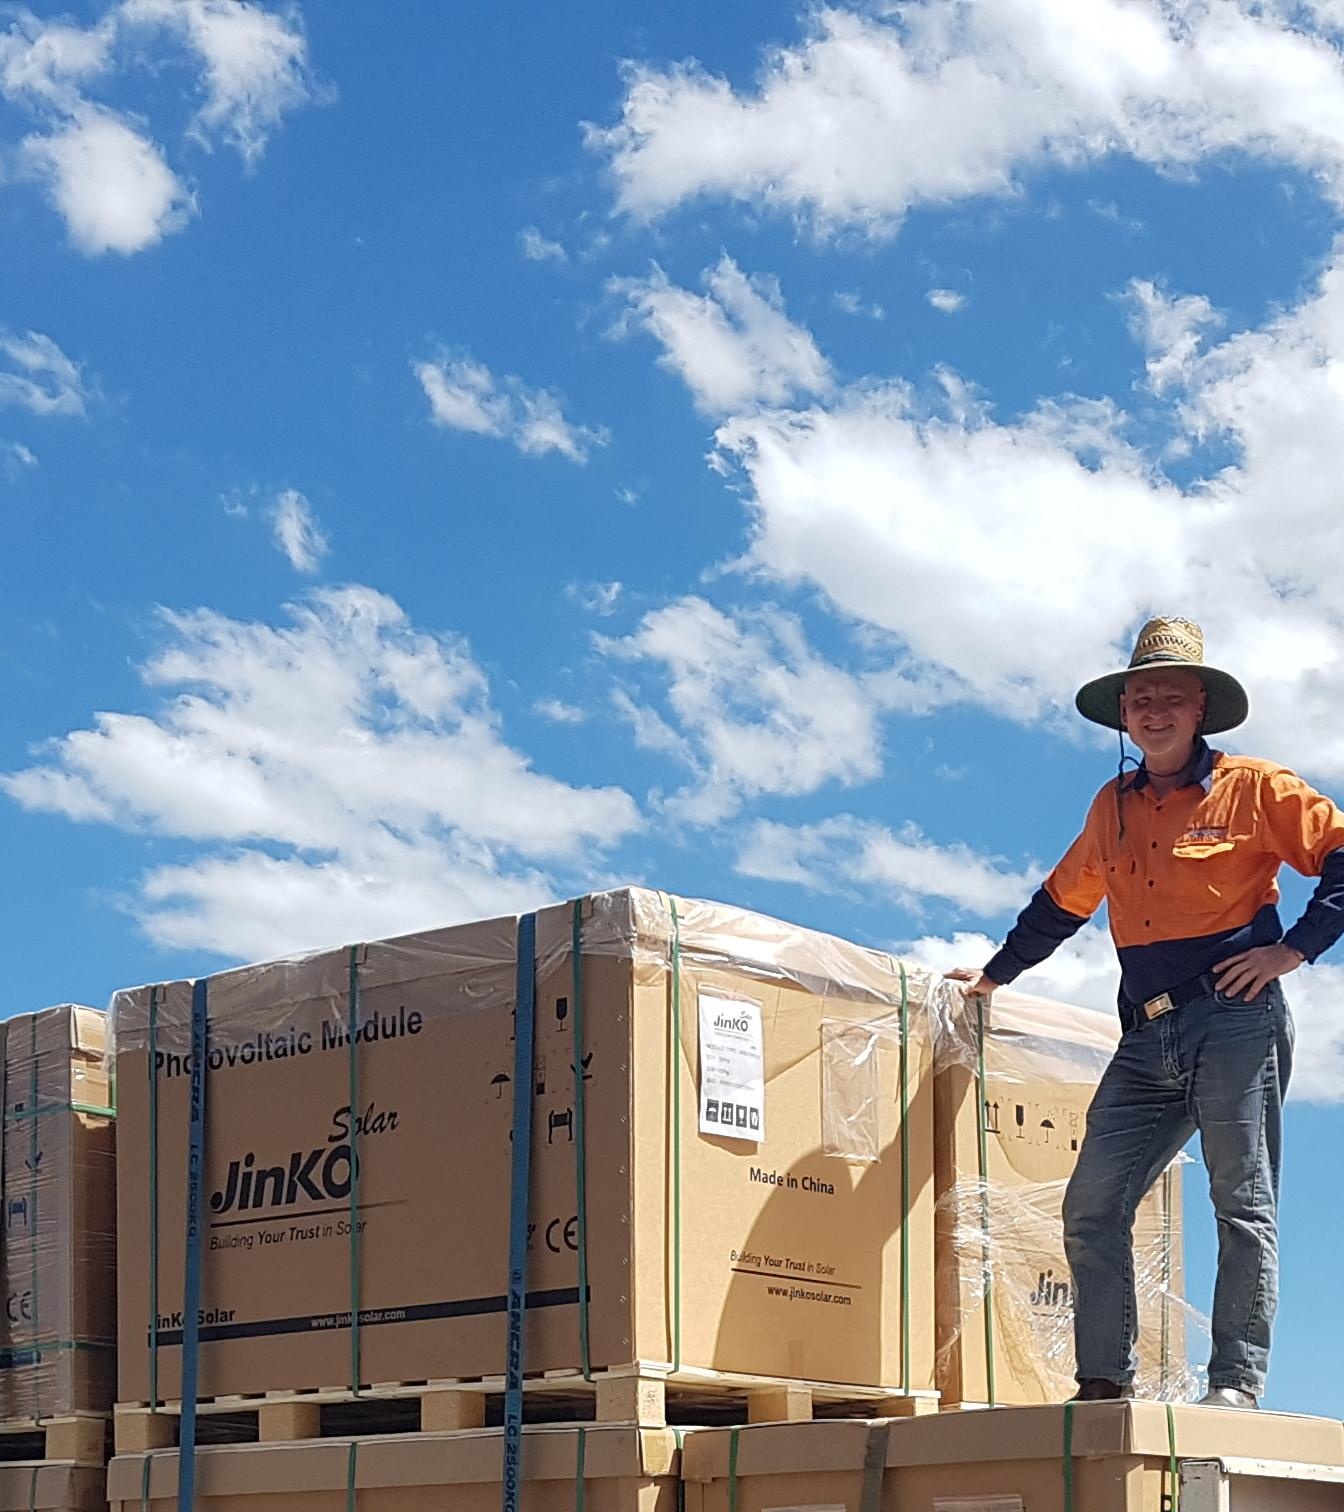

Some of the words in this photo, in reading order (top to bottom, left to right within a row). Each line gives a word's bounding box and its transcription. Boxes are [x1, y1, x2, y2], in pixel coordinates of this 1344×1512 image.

[210, 1145, 360, 1214] JinKO
[749, 1167, 784, 1187] Made
[787, 1173, 798, 1189] in
[801, 1176, 835, 1195] China
[258, 1230, 286, 1246] Your
[289, 1226, 321, 1242] Trust
[323, 1223, 333, 1237] in
[336, 1220, 367, 1236] Soar
[763, 1255, 783, 1267] Your
[785, 1258, 806, 1273] Trust
[807, 1262, 814, 1273] in
[815, 1263, 836, 1276] Solar
[767, 1286, 852, 1306] www.jinkosolar.com
[1030, 1269, 1075, 1307] Jin
[509, 1289, 522, 1390] ANCRA
[507, 1414, 517, 1437] LC
